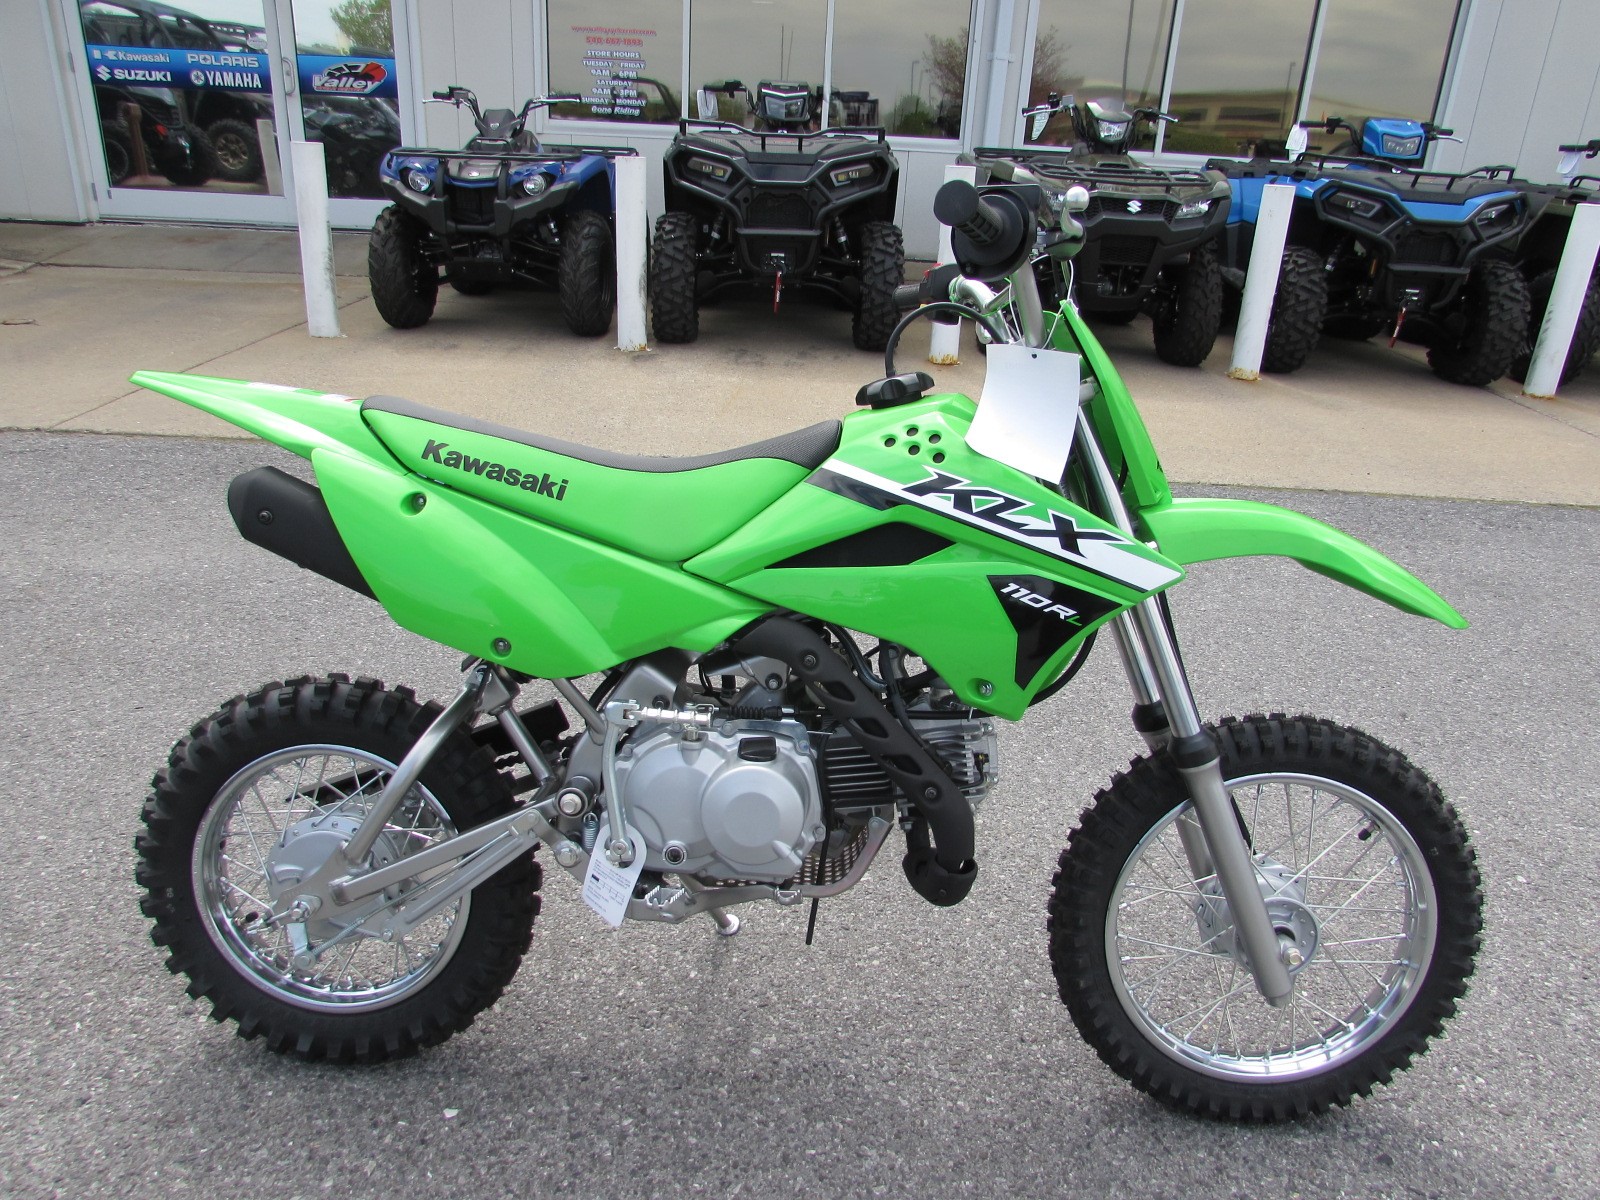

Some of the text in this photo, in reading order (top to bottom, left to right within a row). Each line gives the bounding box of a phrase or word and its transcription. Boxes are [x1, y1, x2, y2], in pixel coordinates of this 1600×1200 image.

[117, 51, 170, 63] Kawasaki
[186, 53, 259, 68] POLARIS
[114, 69, 171, 82] SUZUKI
[206, 70, 262, 89] YAMAHA
[619, 70, 637, 78] 6PM
[314, 75, 381, 93] Valley
[619, 89, 637, 97] 3PM
[616, 98, 647, 106] MONDAY
[591, 106, 640, 116] Gone Riding
[421, 439, 569, 501] Kawasaki
[901, 466, 1131, 559] KLX
